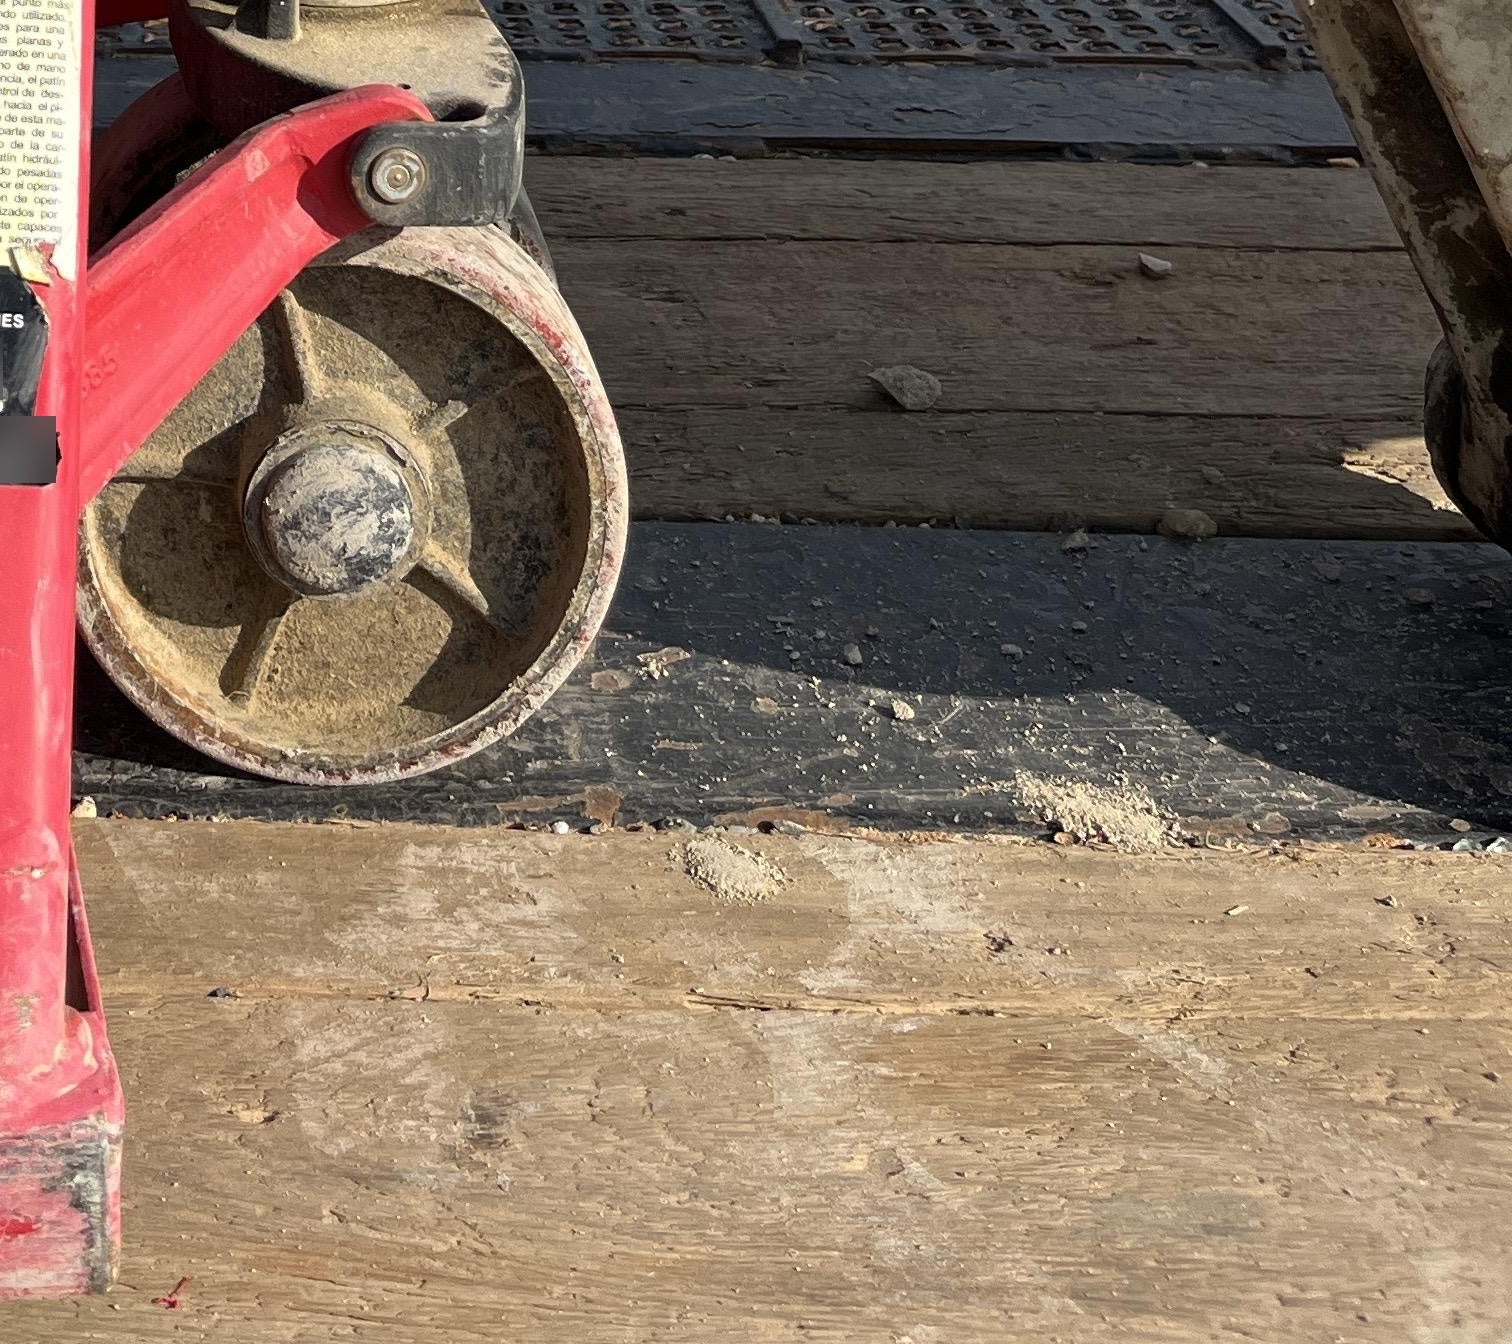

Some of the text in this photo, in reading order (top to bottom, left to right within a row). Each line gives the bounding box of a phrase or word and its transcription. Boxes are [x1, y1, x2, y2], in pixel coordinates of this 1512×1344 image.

[16, 61, 30, 70] de
[26, 74, 37, 84] el
[30, 127, 45, 137] de
